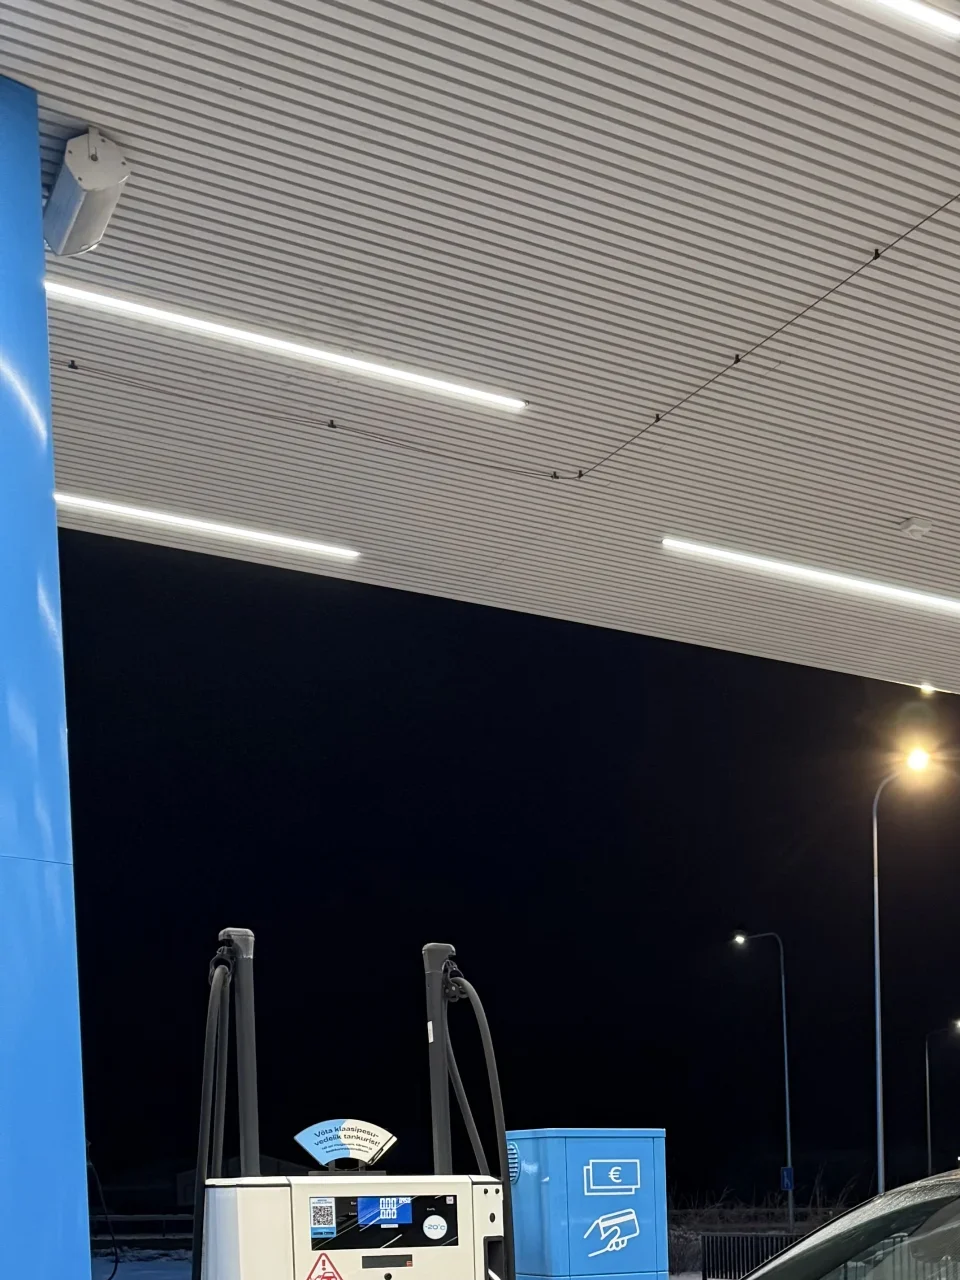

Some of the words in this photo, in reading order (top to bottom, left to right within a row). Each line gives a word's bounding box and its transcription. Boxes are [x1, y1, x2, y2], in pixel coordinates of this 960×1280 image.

[334, 1126, 379, 1138] klaasipesu-
[314, 1134, 341, 1146] vedelik
[344, 1134, 381, 1147] tankurist!
